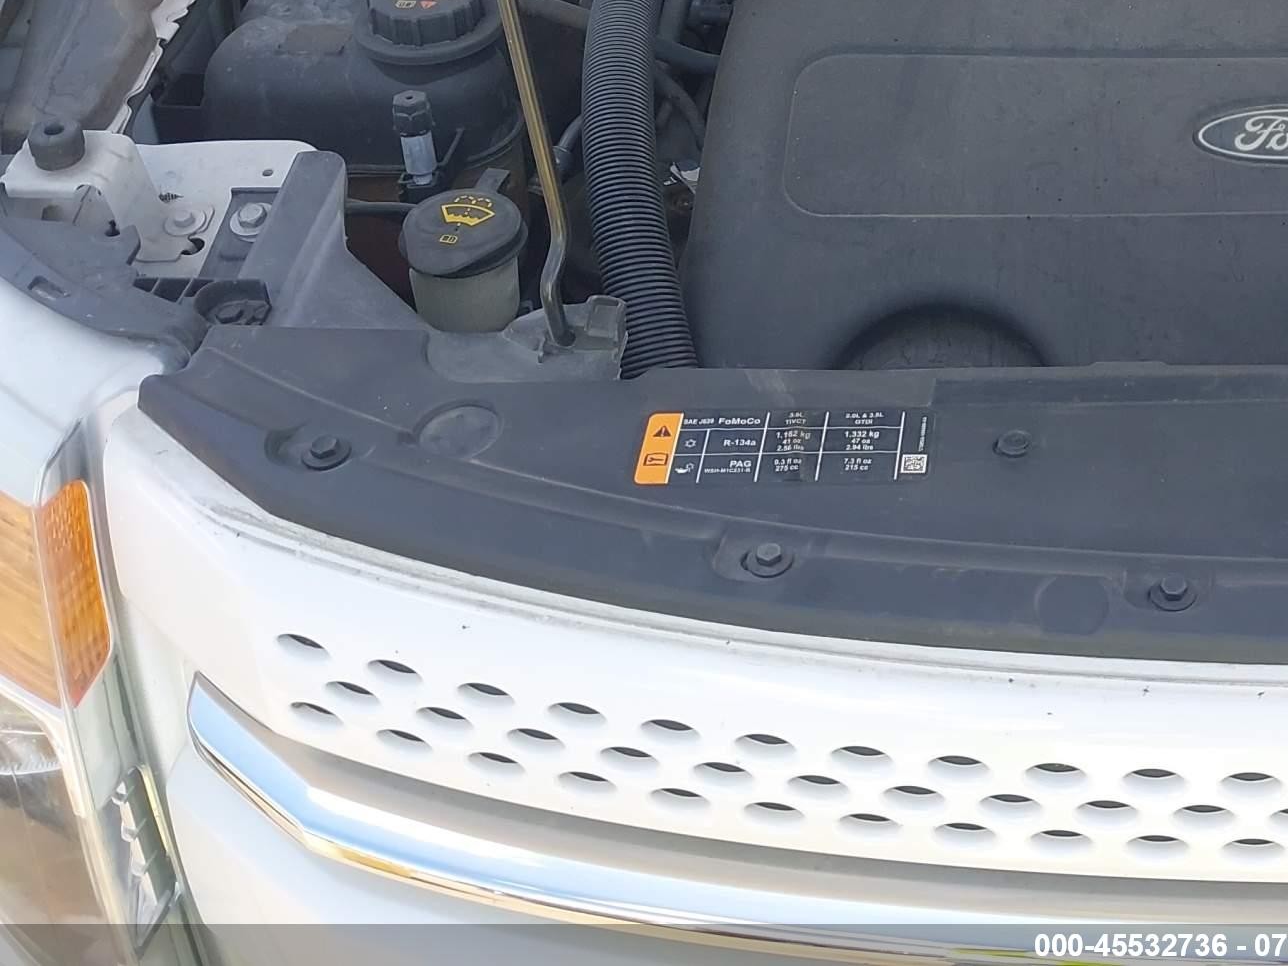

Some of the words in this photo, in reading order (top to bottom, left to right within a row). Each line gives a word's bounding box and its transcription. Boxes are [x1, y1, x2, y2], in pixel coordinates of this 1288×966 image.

[718, 417, 761, 425] FoMoCo
[800, 430, 811, 439] kg
[844, 430, 867, 438] 1.332
[868, 429, 880, 439] kg
[723, 439, 757, 447] R-134a
[730, 460, 752, 468] PAG
